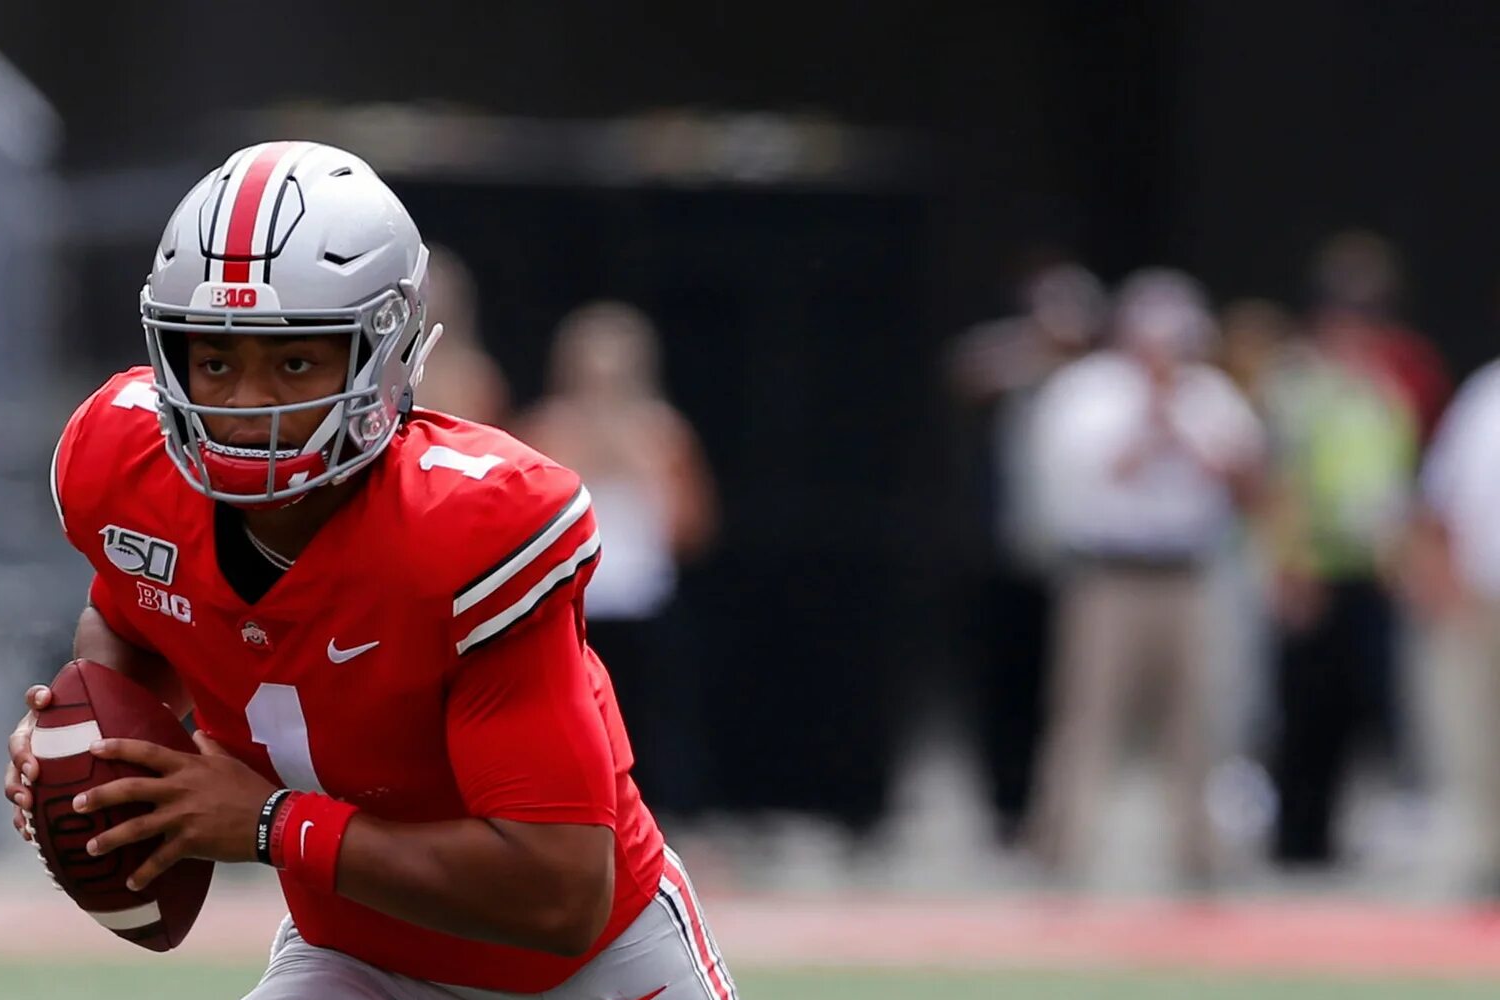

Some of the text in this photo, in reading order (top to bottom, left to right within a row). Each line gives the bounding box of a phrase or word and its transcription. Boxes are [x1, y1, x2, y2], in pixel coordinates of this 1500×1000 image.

[419, 445, 504, 480] 1
[99, 524, 178, 585] 150
[246, 682, 327, 794] 1
